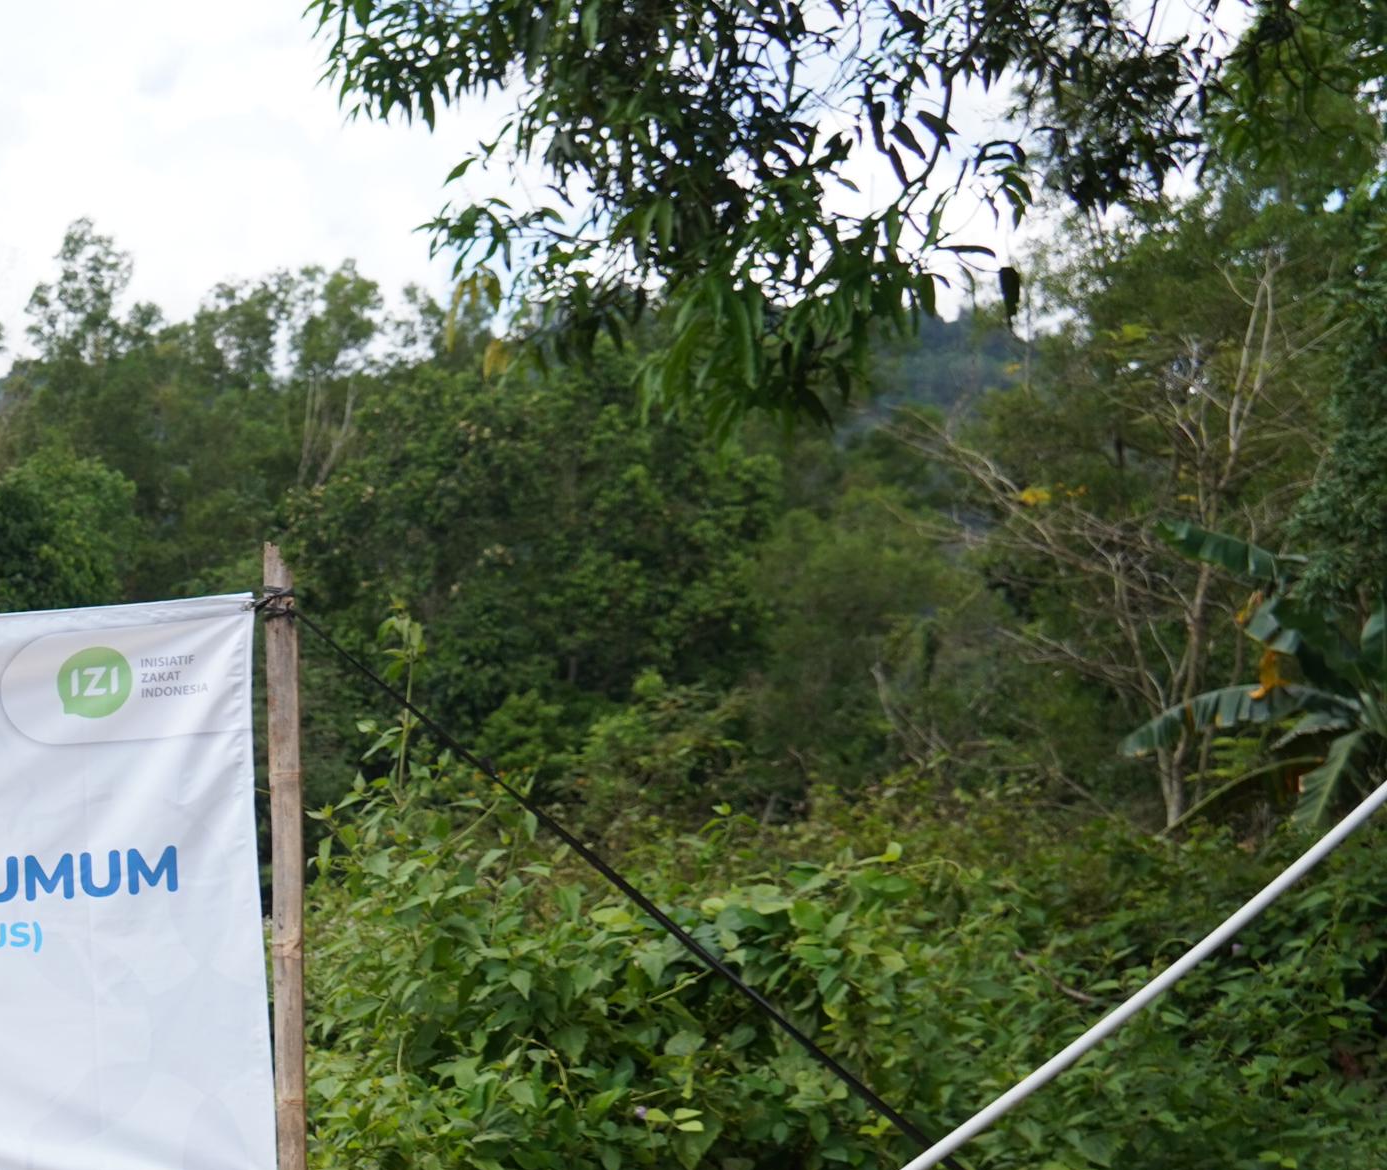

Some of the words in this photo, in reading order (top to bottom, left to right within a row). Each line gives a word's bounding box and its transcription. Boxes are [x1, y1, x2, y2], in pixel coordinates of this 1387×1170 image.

[140, 654, 195, 668] INISIATIF
[70, 667, 119, 697] IZI
[141, 670, 182, 683] ZAKAT
[141, 683, 208, 698] INDONESIA
